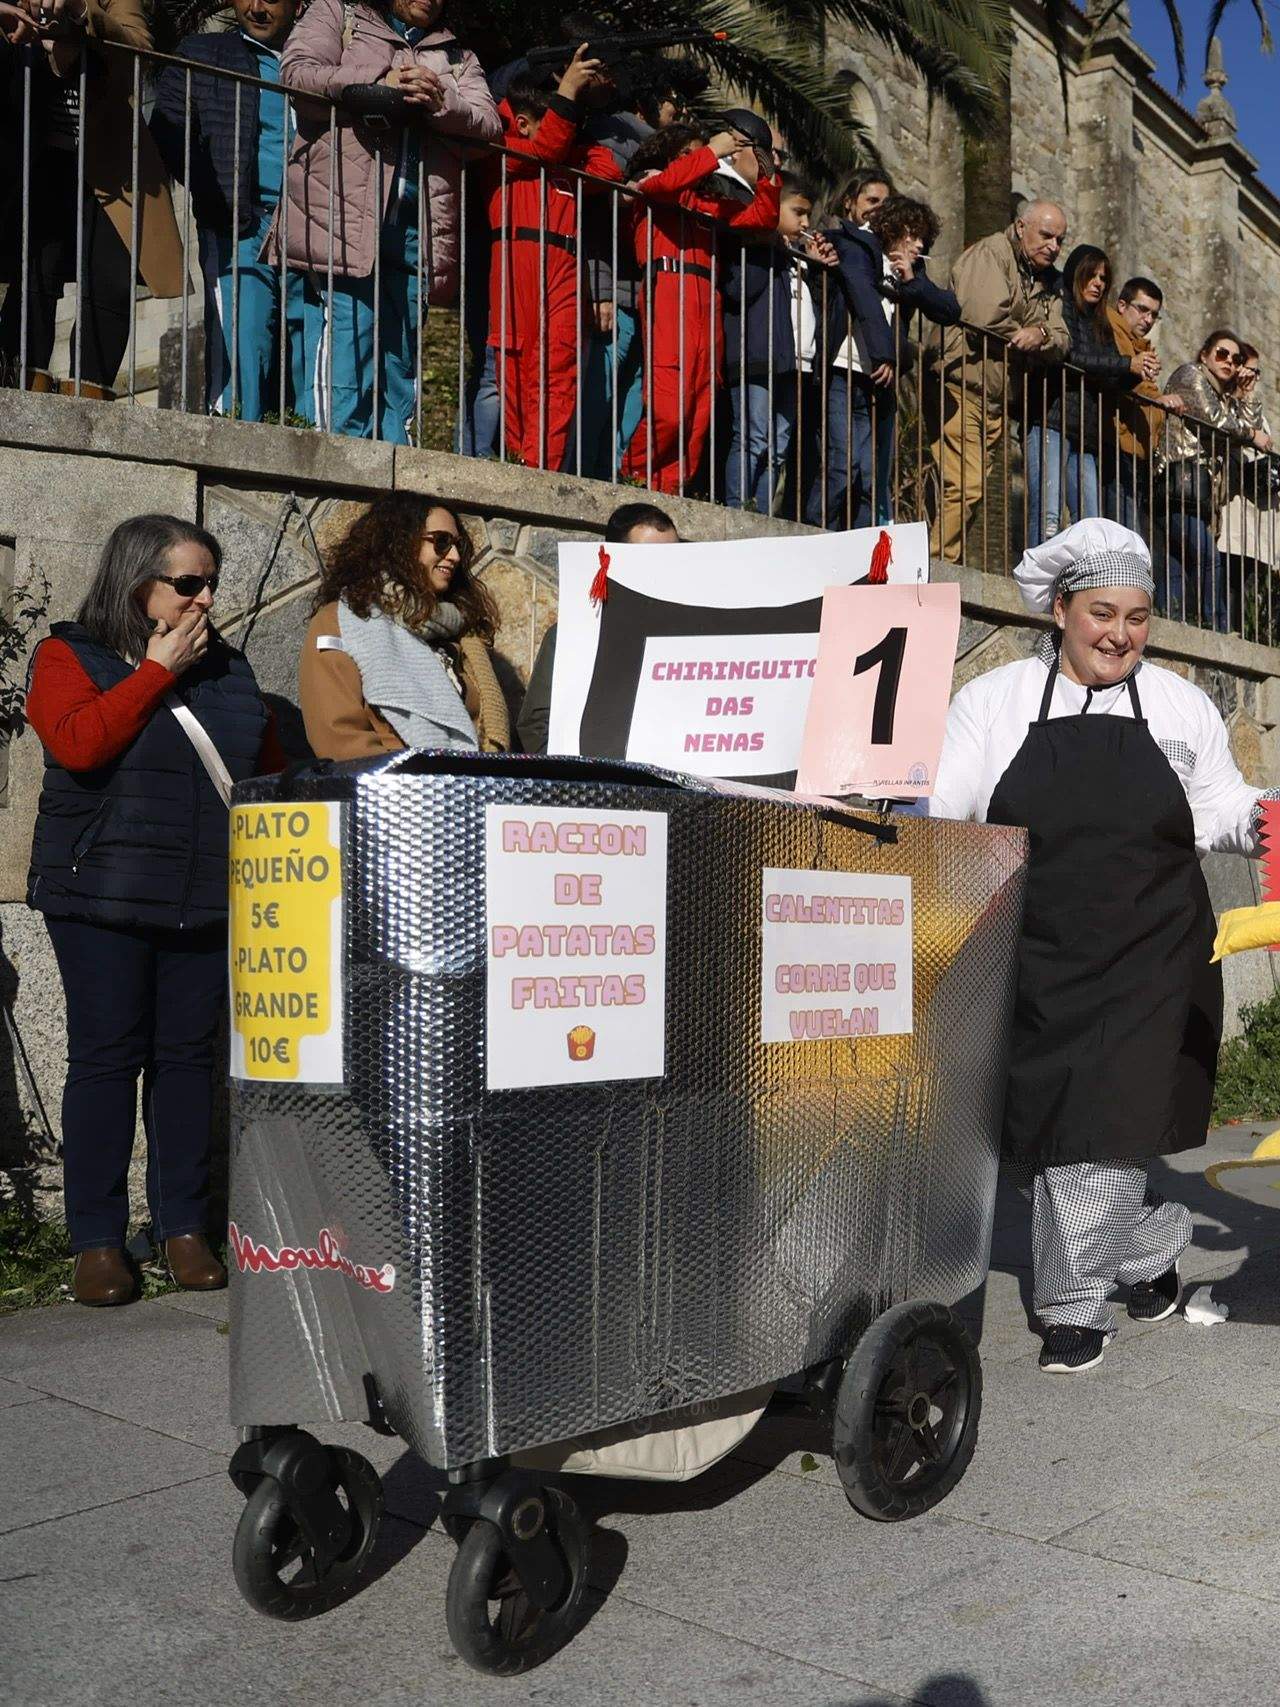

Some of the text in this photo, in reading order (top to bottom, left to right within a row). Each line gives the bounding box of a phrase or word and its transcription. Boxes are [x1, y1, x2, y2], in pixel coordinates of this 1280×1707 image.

[853, 627, 908, 745] 1
[705, 697, 754, 716] DAS
[684, 732, 764, 752] NENAS
[502, 820, 647, 856] RACION
[230, 848, 330, 889] PEQUEÑO
[554, 873, 603, 906] DE
[251, 902, 280, 929] 5€
[765, 893, 905, 926] CALENTITAS
[492, 925, 656, 958] PATATAS
[511, 974, 646, 1010] FRITAS
[774, 962, 897, 994] CORRE QUE
[234, 991, 319, 1019] GRANDE
[789, 1006, 879, 1040] VUELAN
[249, 1036, 291, 1064] 10€
